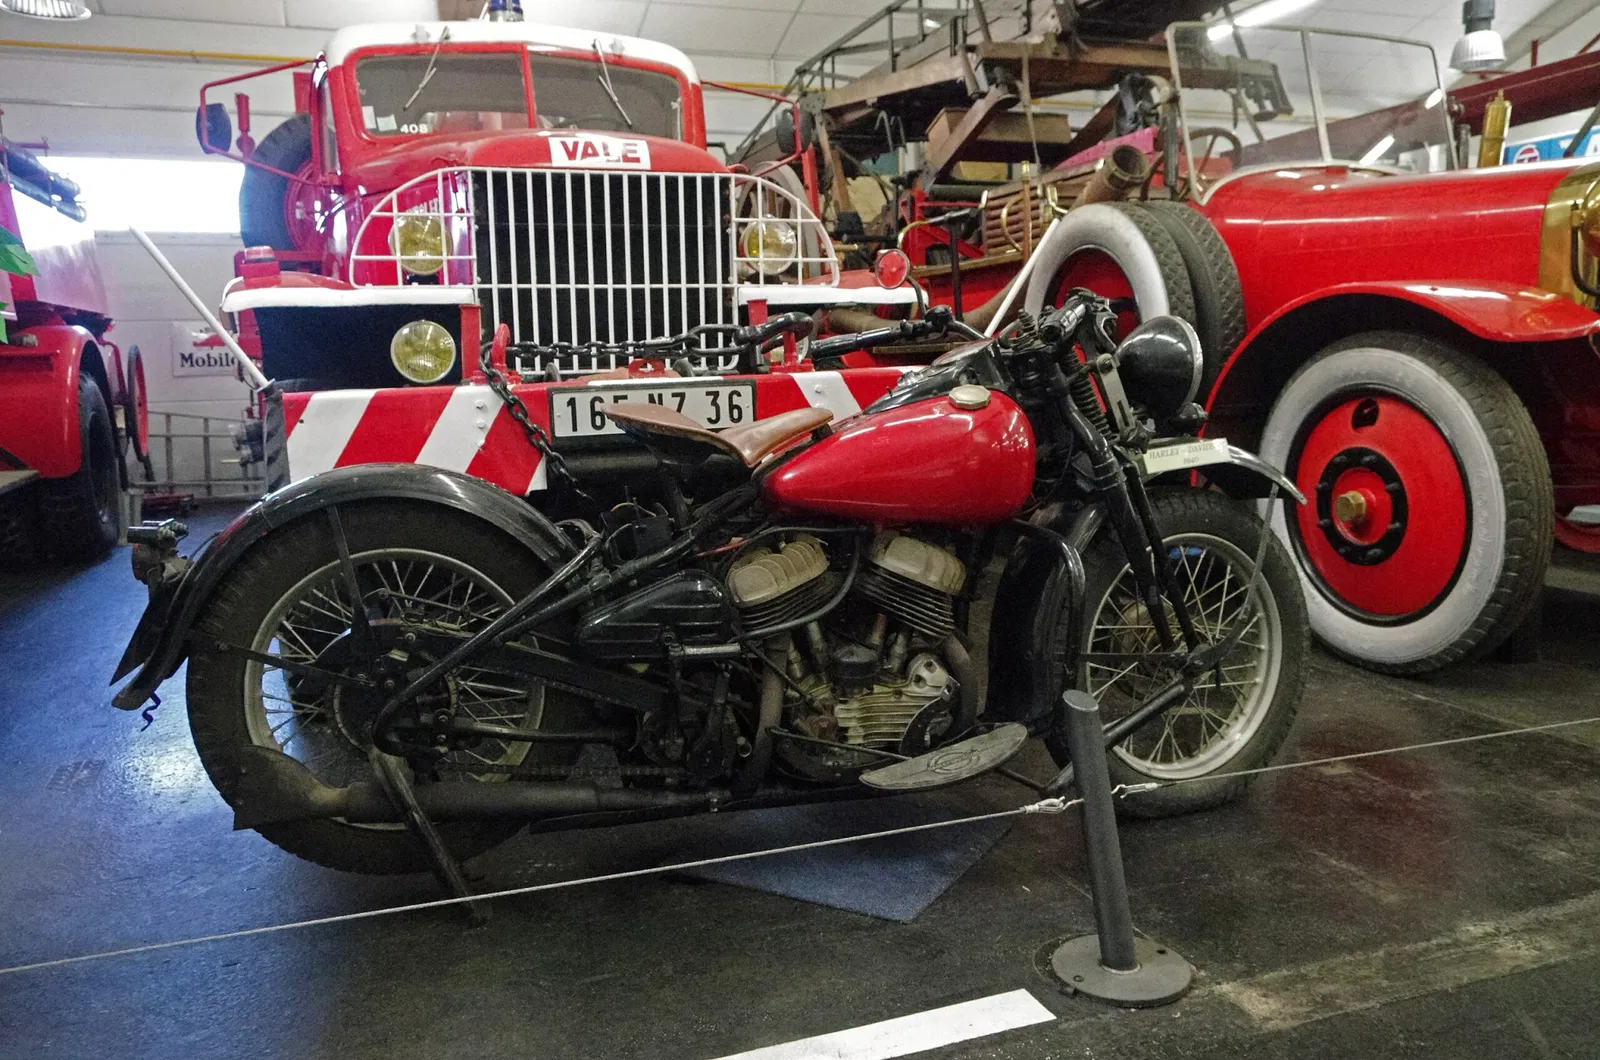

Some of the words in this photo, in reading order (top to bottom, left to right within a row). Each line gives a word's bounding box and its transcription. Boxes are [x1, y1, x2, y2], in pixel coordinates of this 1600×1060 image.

[400, 123, 429, 134] 408
[560, 140, 641, 163] VALE
[566, 395, 628, 432] 16
[705, 389, 743, 425] 36
[1149, 447, 1180, 460] HARLEY
